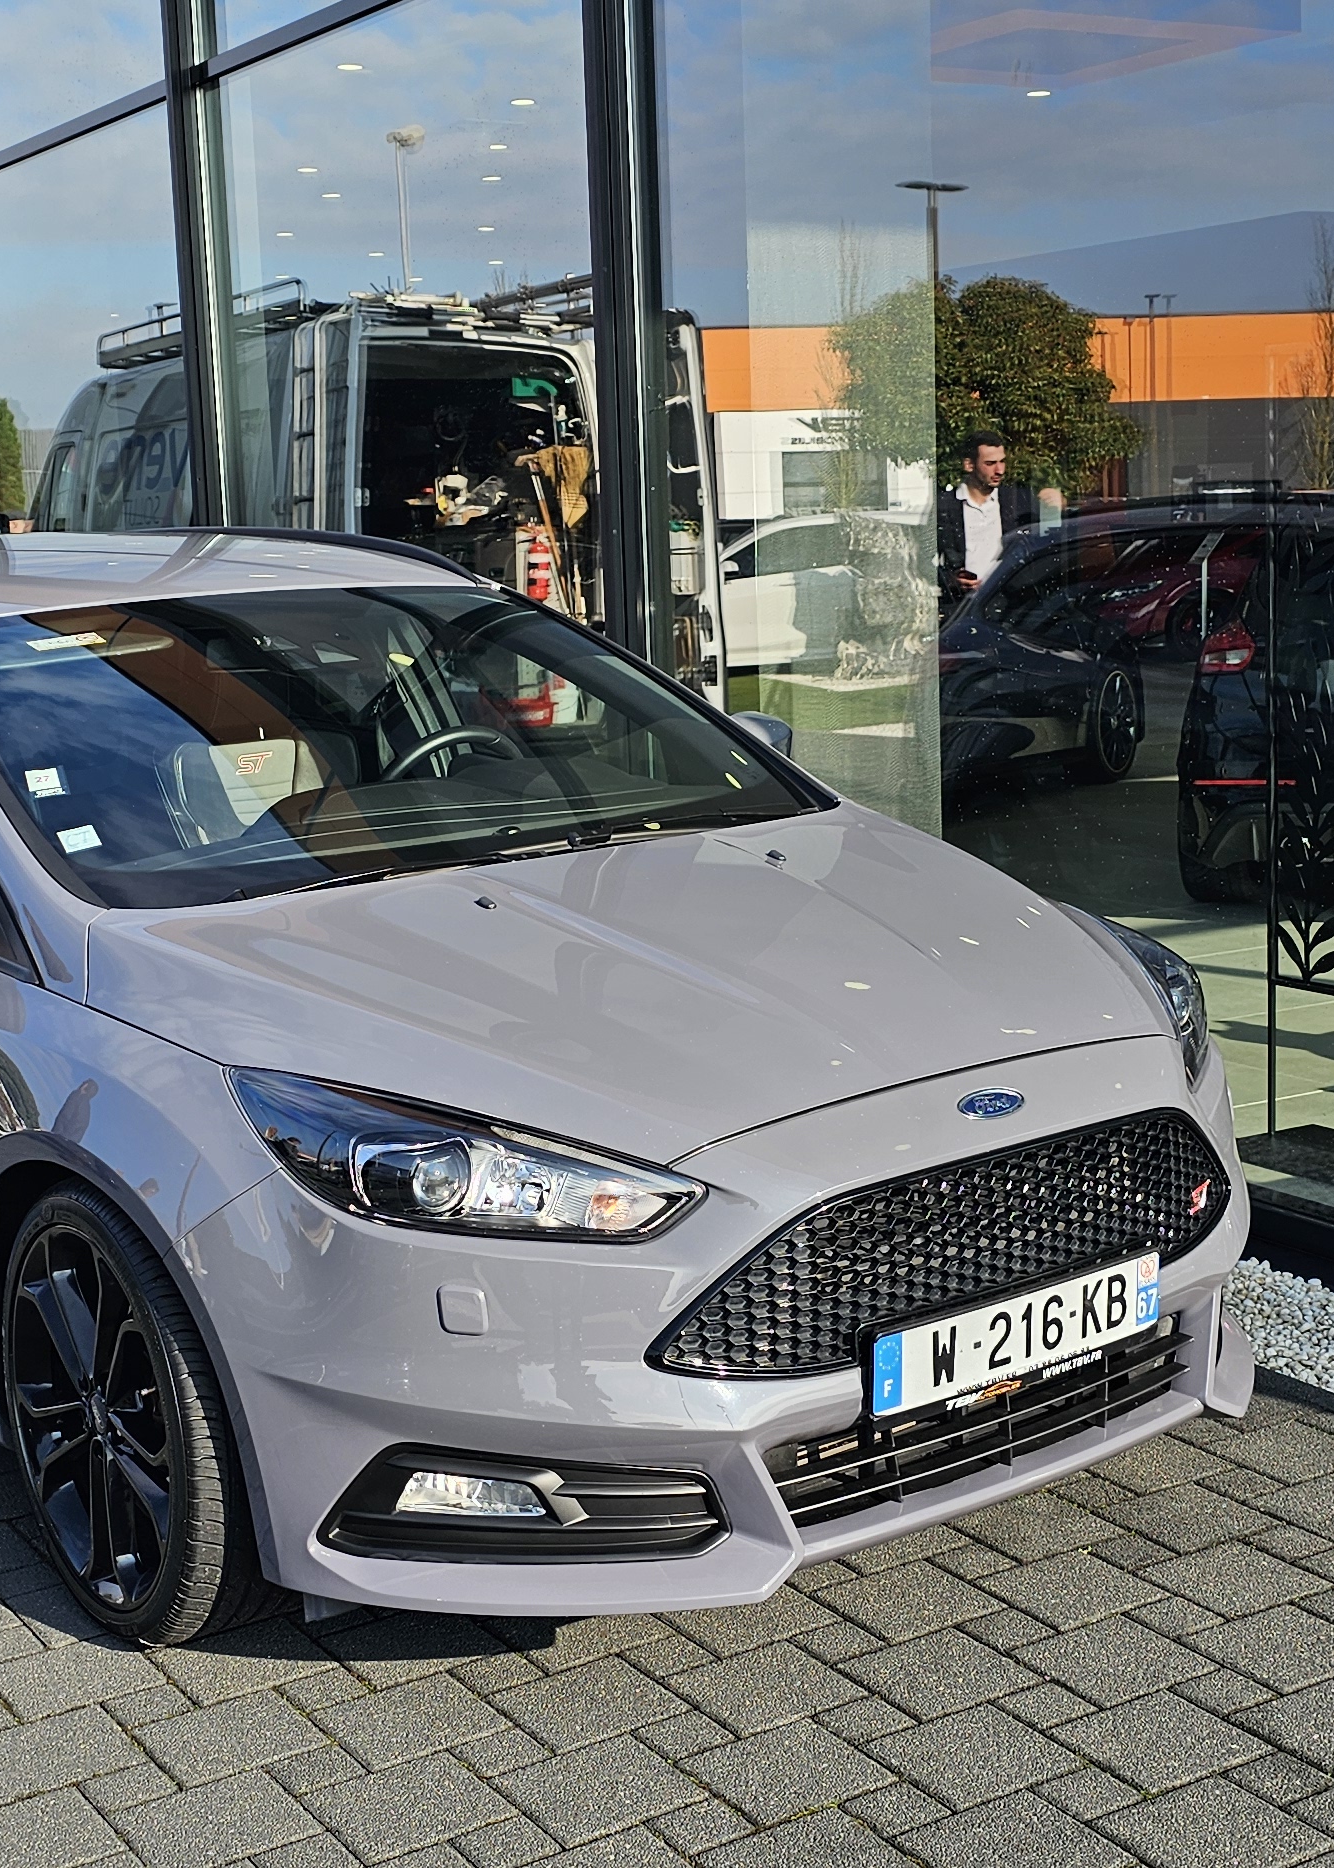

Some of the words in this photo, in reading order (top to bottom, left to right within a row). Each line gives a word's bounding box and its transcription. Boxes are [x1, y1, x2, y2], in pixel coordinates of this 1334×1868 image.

[235, 750, 273, 775] ST
[34, 774, 50, 784] 27
[973, 1094, 1011, 1115] Ford
[1137, 1286, 1158, 1319] 67
[1041, 1349, 1103, 1379] WWW.TBV.FR
[883, 1378, 894, 1398] F
